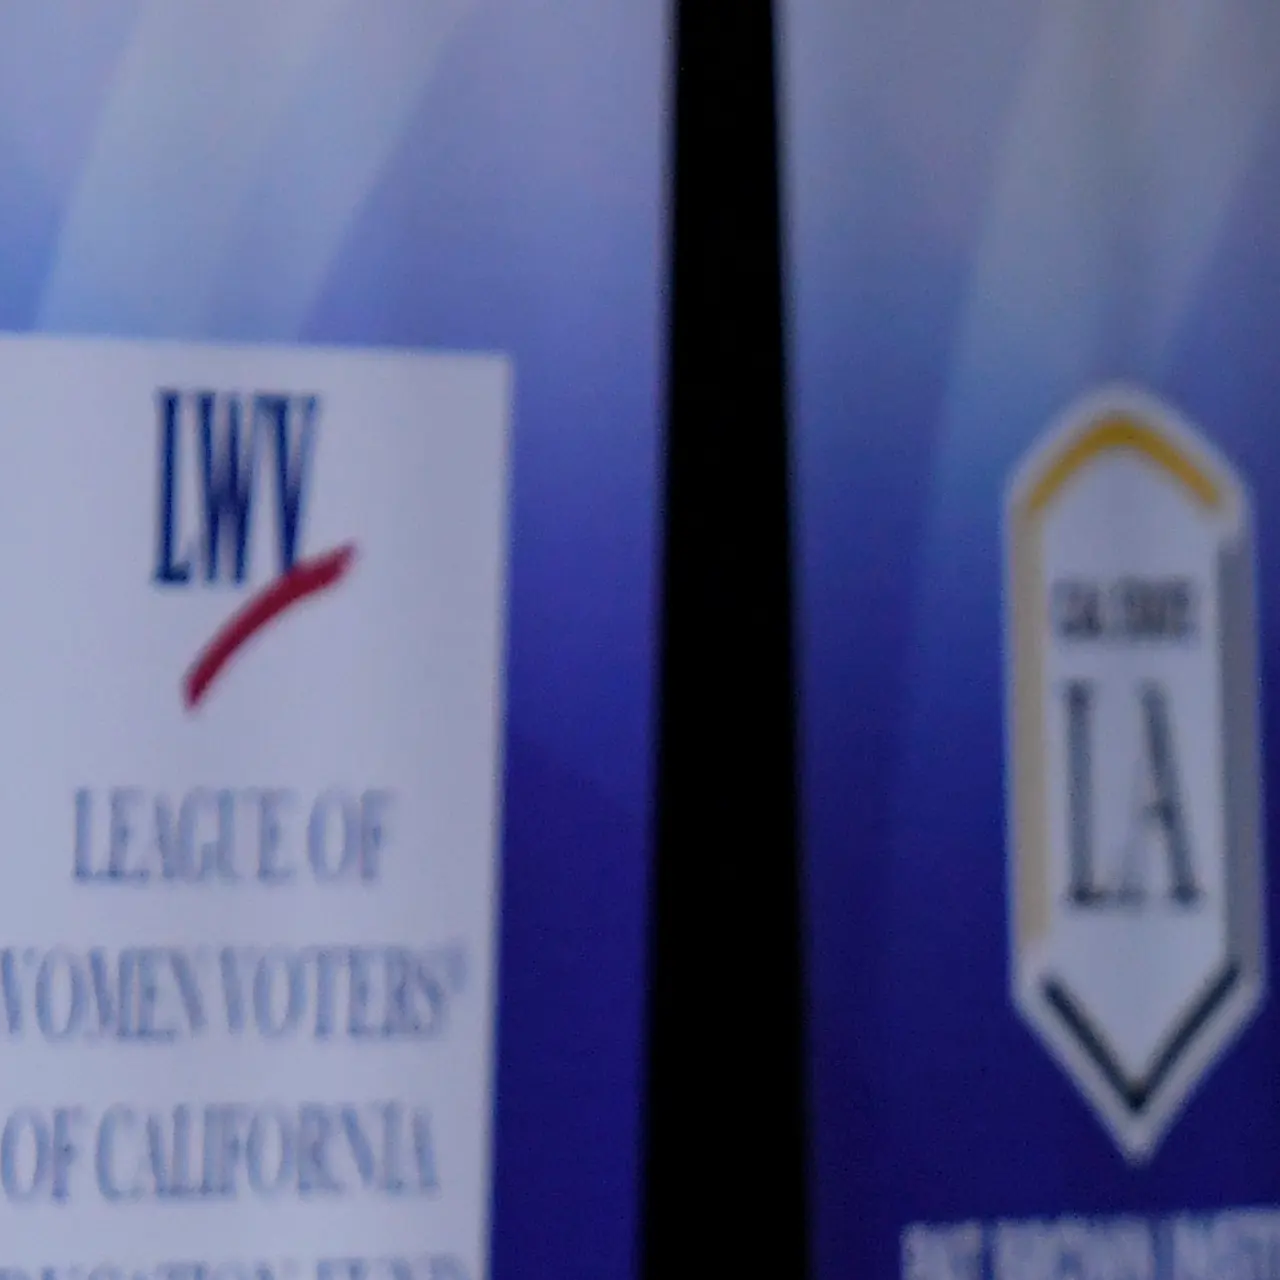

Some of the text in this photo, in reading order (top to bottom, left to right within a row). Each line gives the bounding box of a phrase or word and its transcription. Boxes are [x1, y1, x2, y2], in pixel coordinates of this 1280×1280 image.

[150, 389, 322, 586] LWV
[70, 785, 398, 885] LEAGUE OF
[1061, 677, 1202, 911] LA
[210, 940, 468, 1044] VOTERS
[0, 1098, 441, 1204] OF CALIFORNIA
